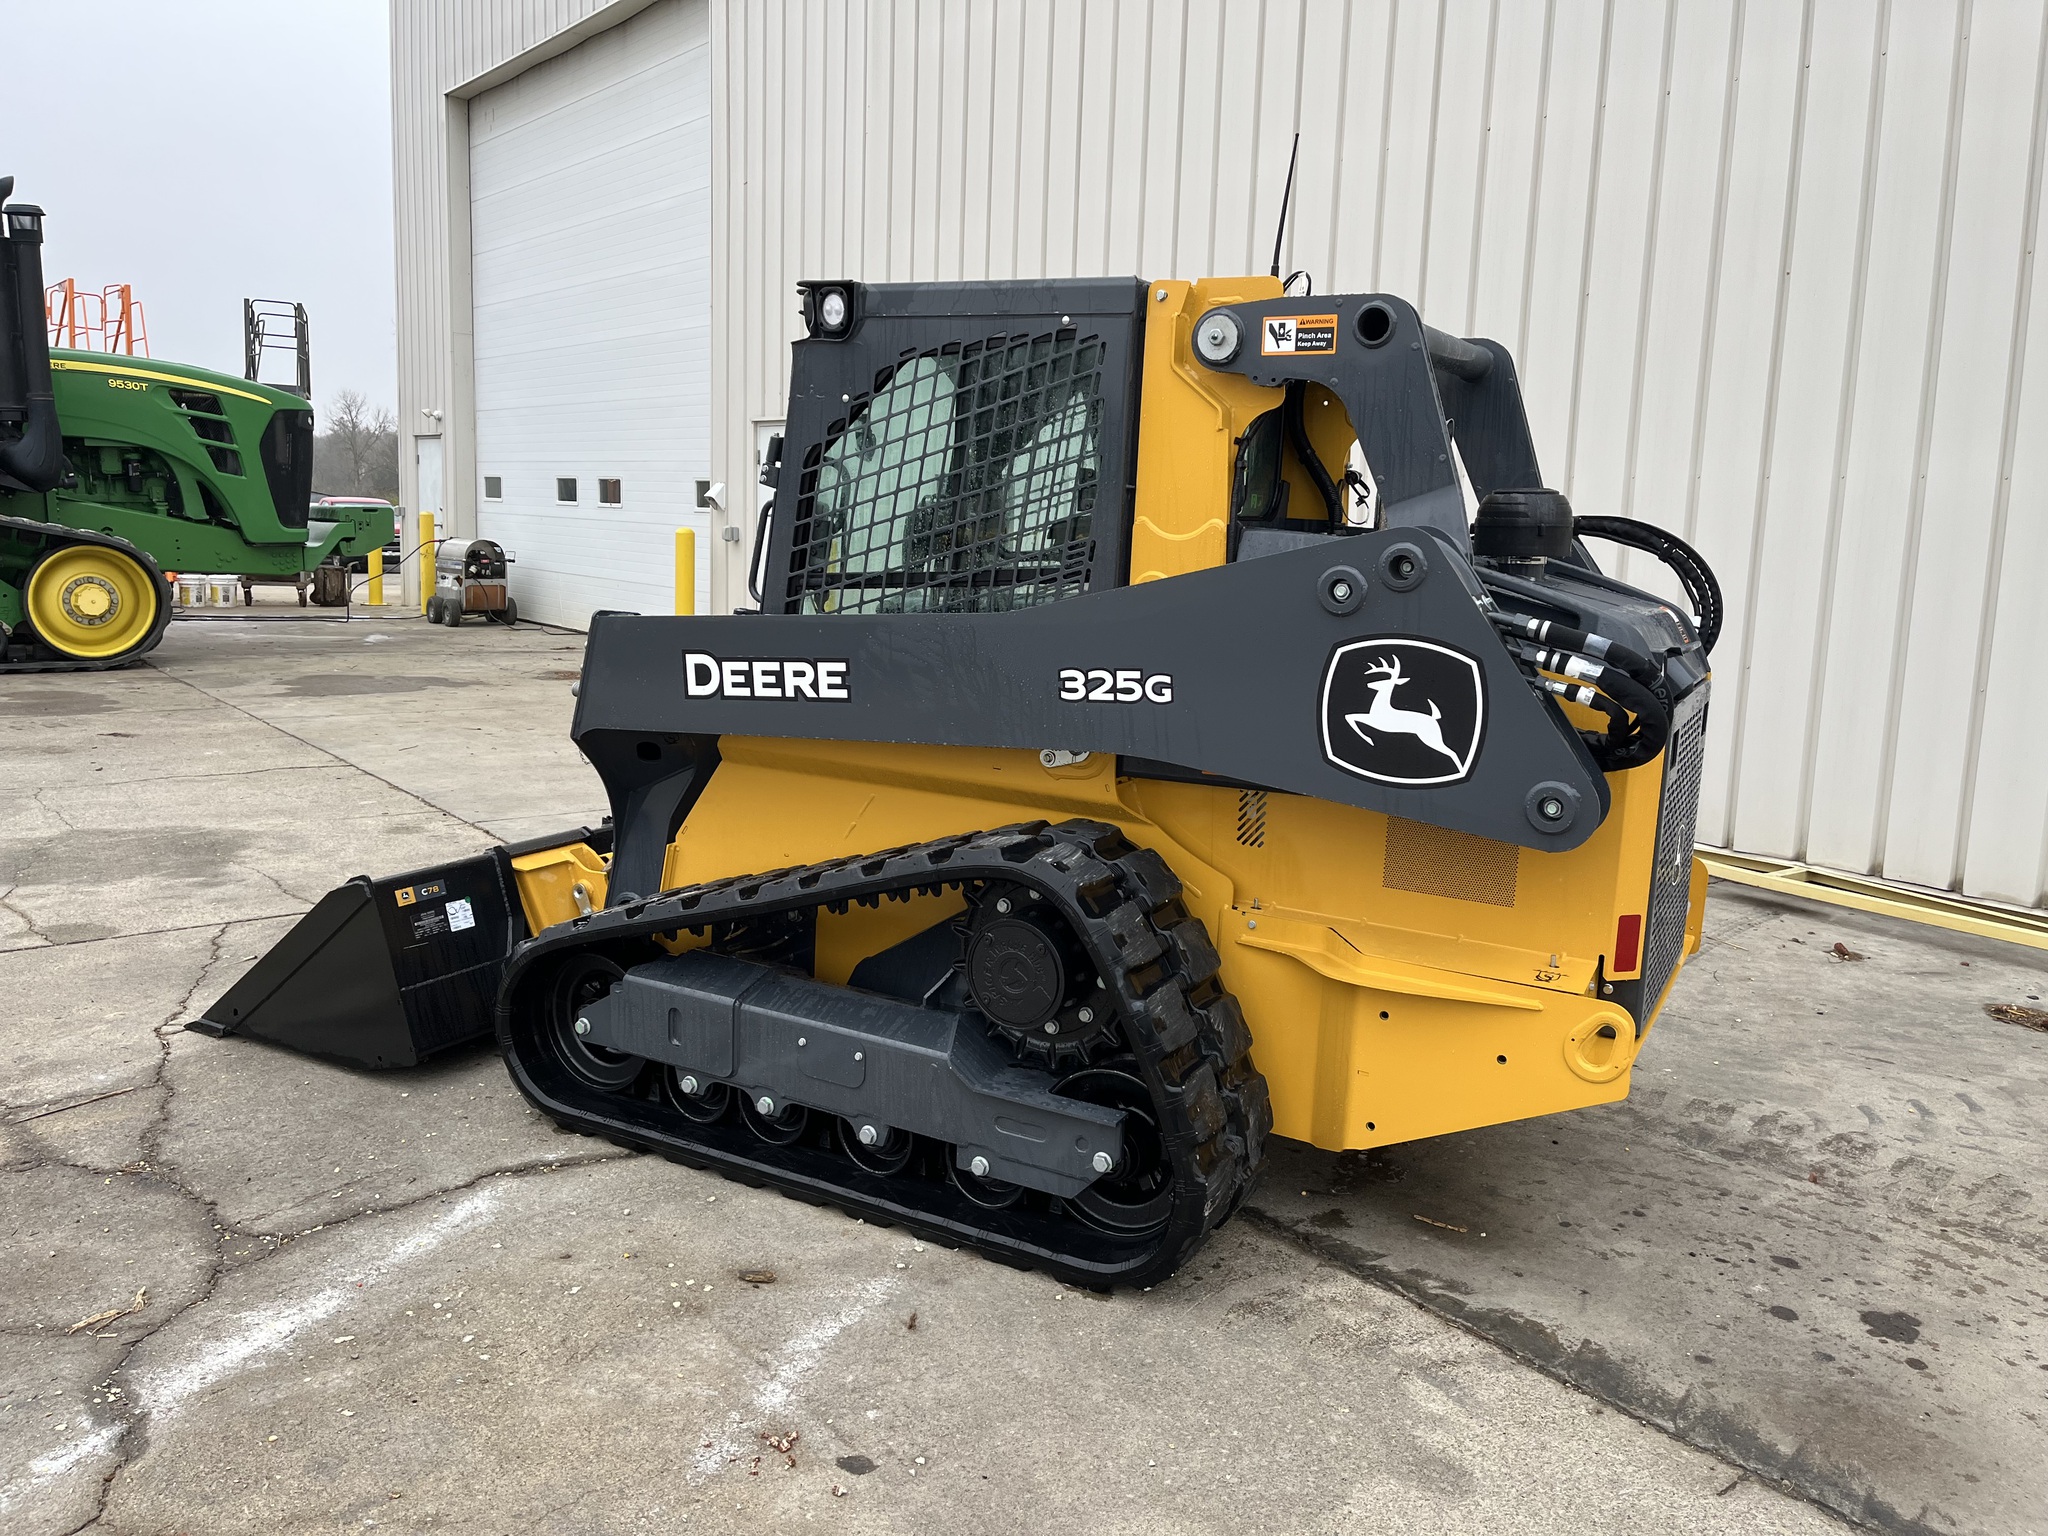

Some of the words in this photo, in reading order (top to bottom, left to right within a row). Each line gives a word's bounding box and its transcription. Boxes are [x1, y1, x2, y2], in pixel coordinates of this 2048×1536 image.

[108, 378, 149, 392] 9530T
[685, 653, 848, 698] DEERE
[1060, 669, 1172, 703] 325G
[421, 885, 440, 896] C78
